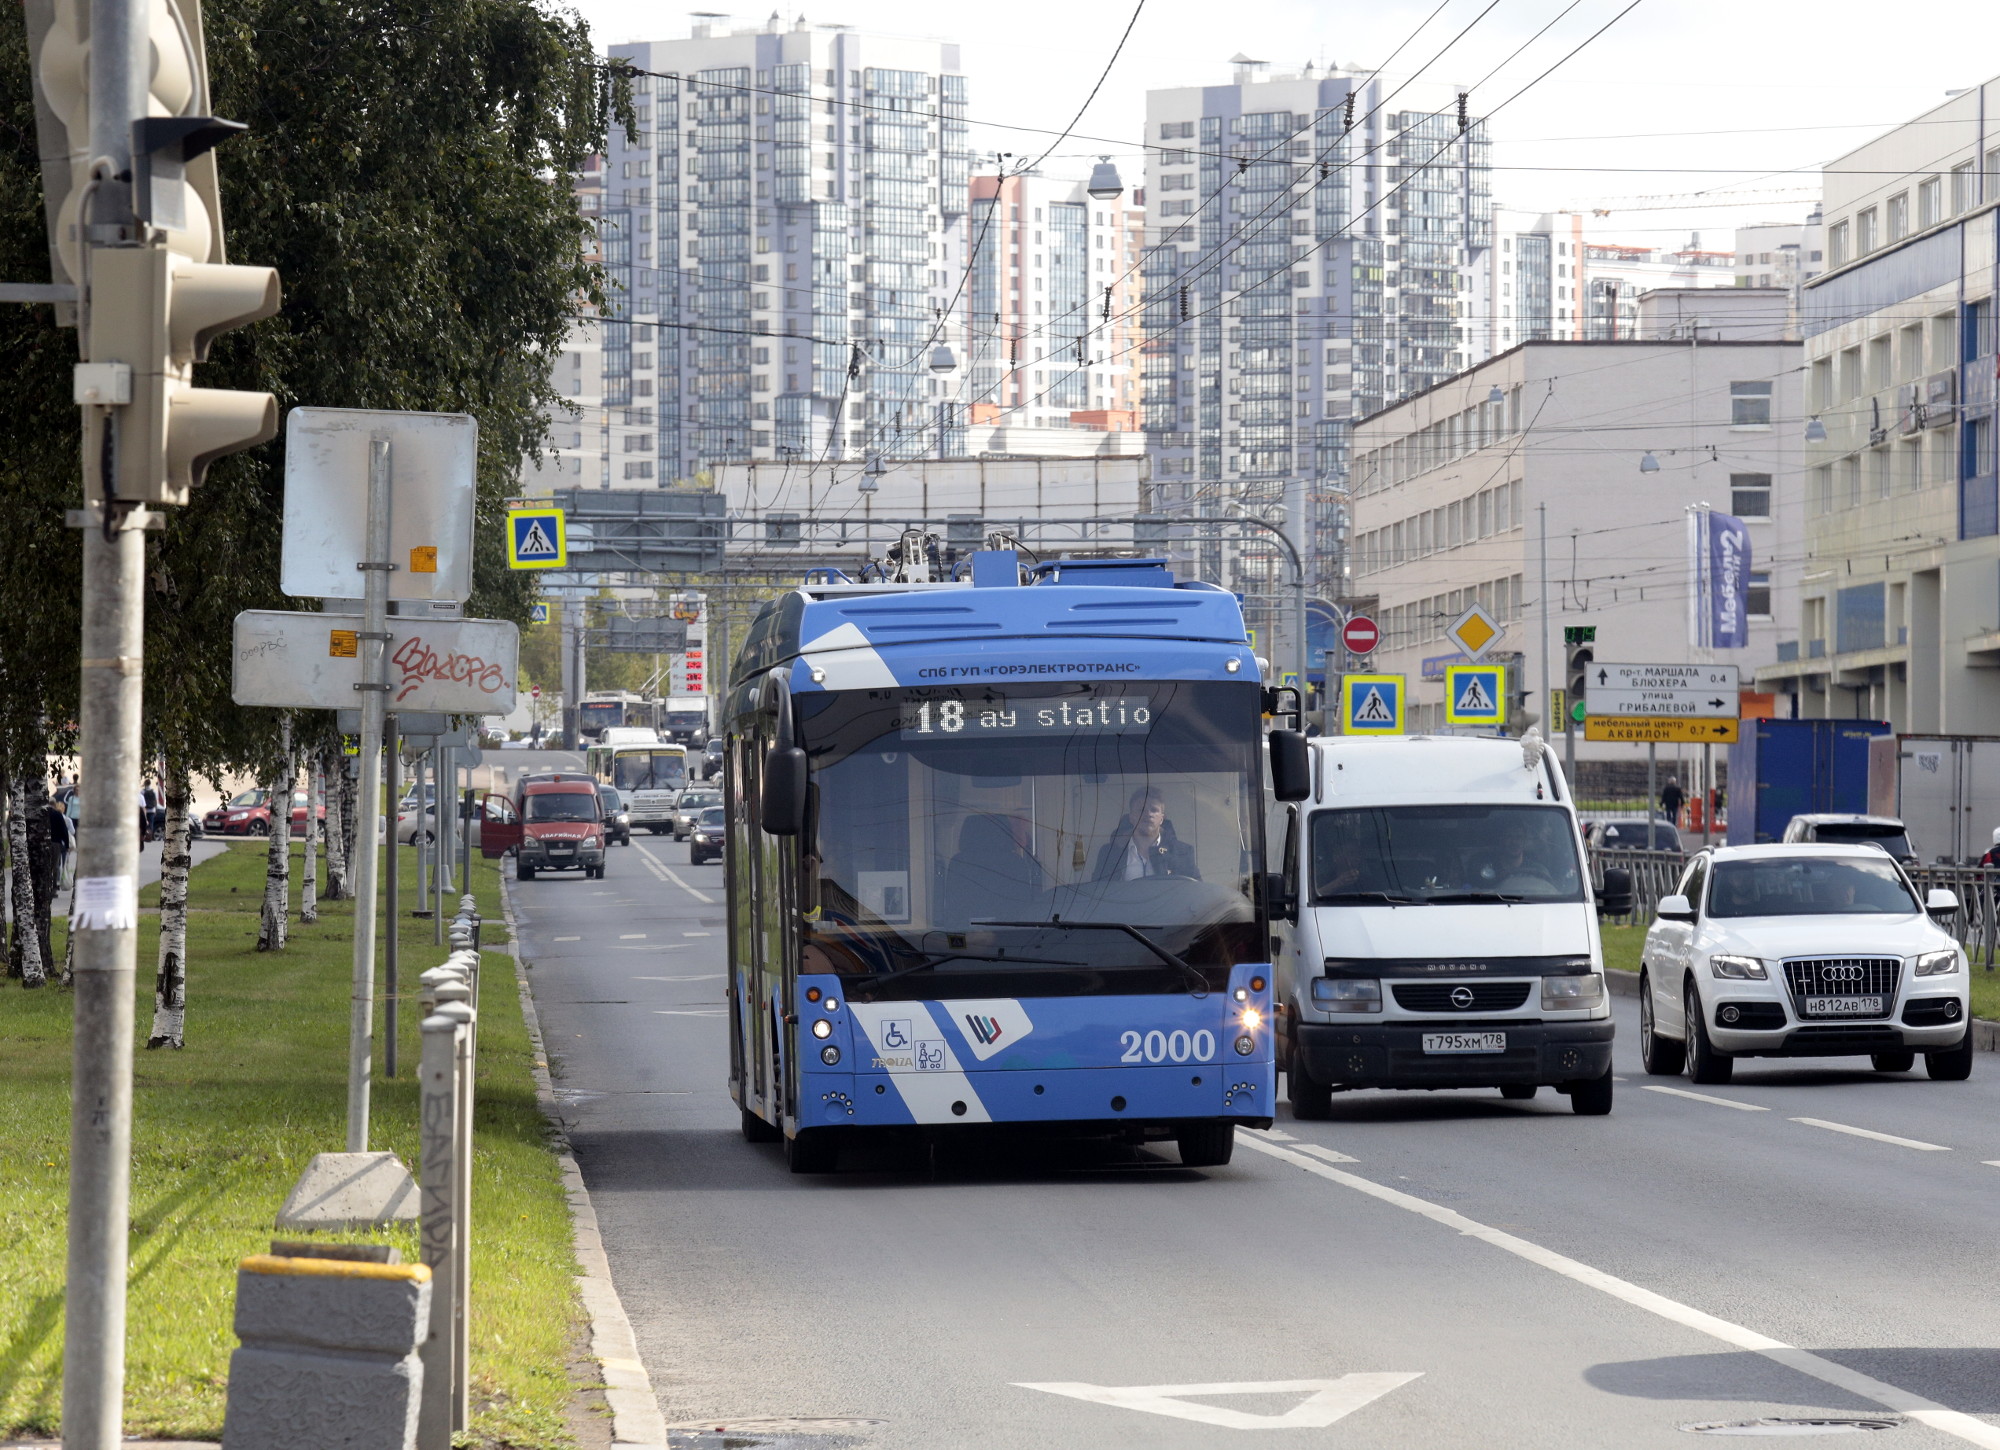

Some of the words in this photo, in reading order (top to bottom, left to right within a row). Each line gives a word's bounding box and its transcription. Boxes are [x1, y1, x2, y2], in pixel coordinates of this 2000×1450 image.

[1720, 544, 1736, 633] Мебель
[918, 667, 947, 678] СПб
[951, 666, 981, 677] ГУП
[984, 663, 1141, 676] «ГОРЭЛЕКТРОТРАНС»
[1645, 668, 1700, 677] МАРШАЛА
[1632, 678, 1687, 688] БЛЮХЕРА
[1642, 692, 1674, 701] улица
[1619, 702, 1696, 713] ГРИБАЛЕВОЙ
[917, 700, 964, 733] 18
[980, 709, 1016, 728] ay
[1038, 700, 1150, 727] statio
[1594, 719, 1650, 728] мебельный
[1654, 721, 1684, 729] центр
[1608, 729, 1670, 739] АКВИЛОН
[1861, 998, 1879, 1007] 178
[1120, 1029, 1216, 1063] 2000
[1427, 1035, 1481, 1049] Т795ХМ
[1482, 1034, 1502, 1045] 178
[422, 1091, 454, 1269] БАГИРА
